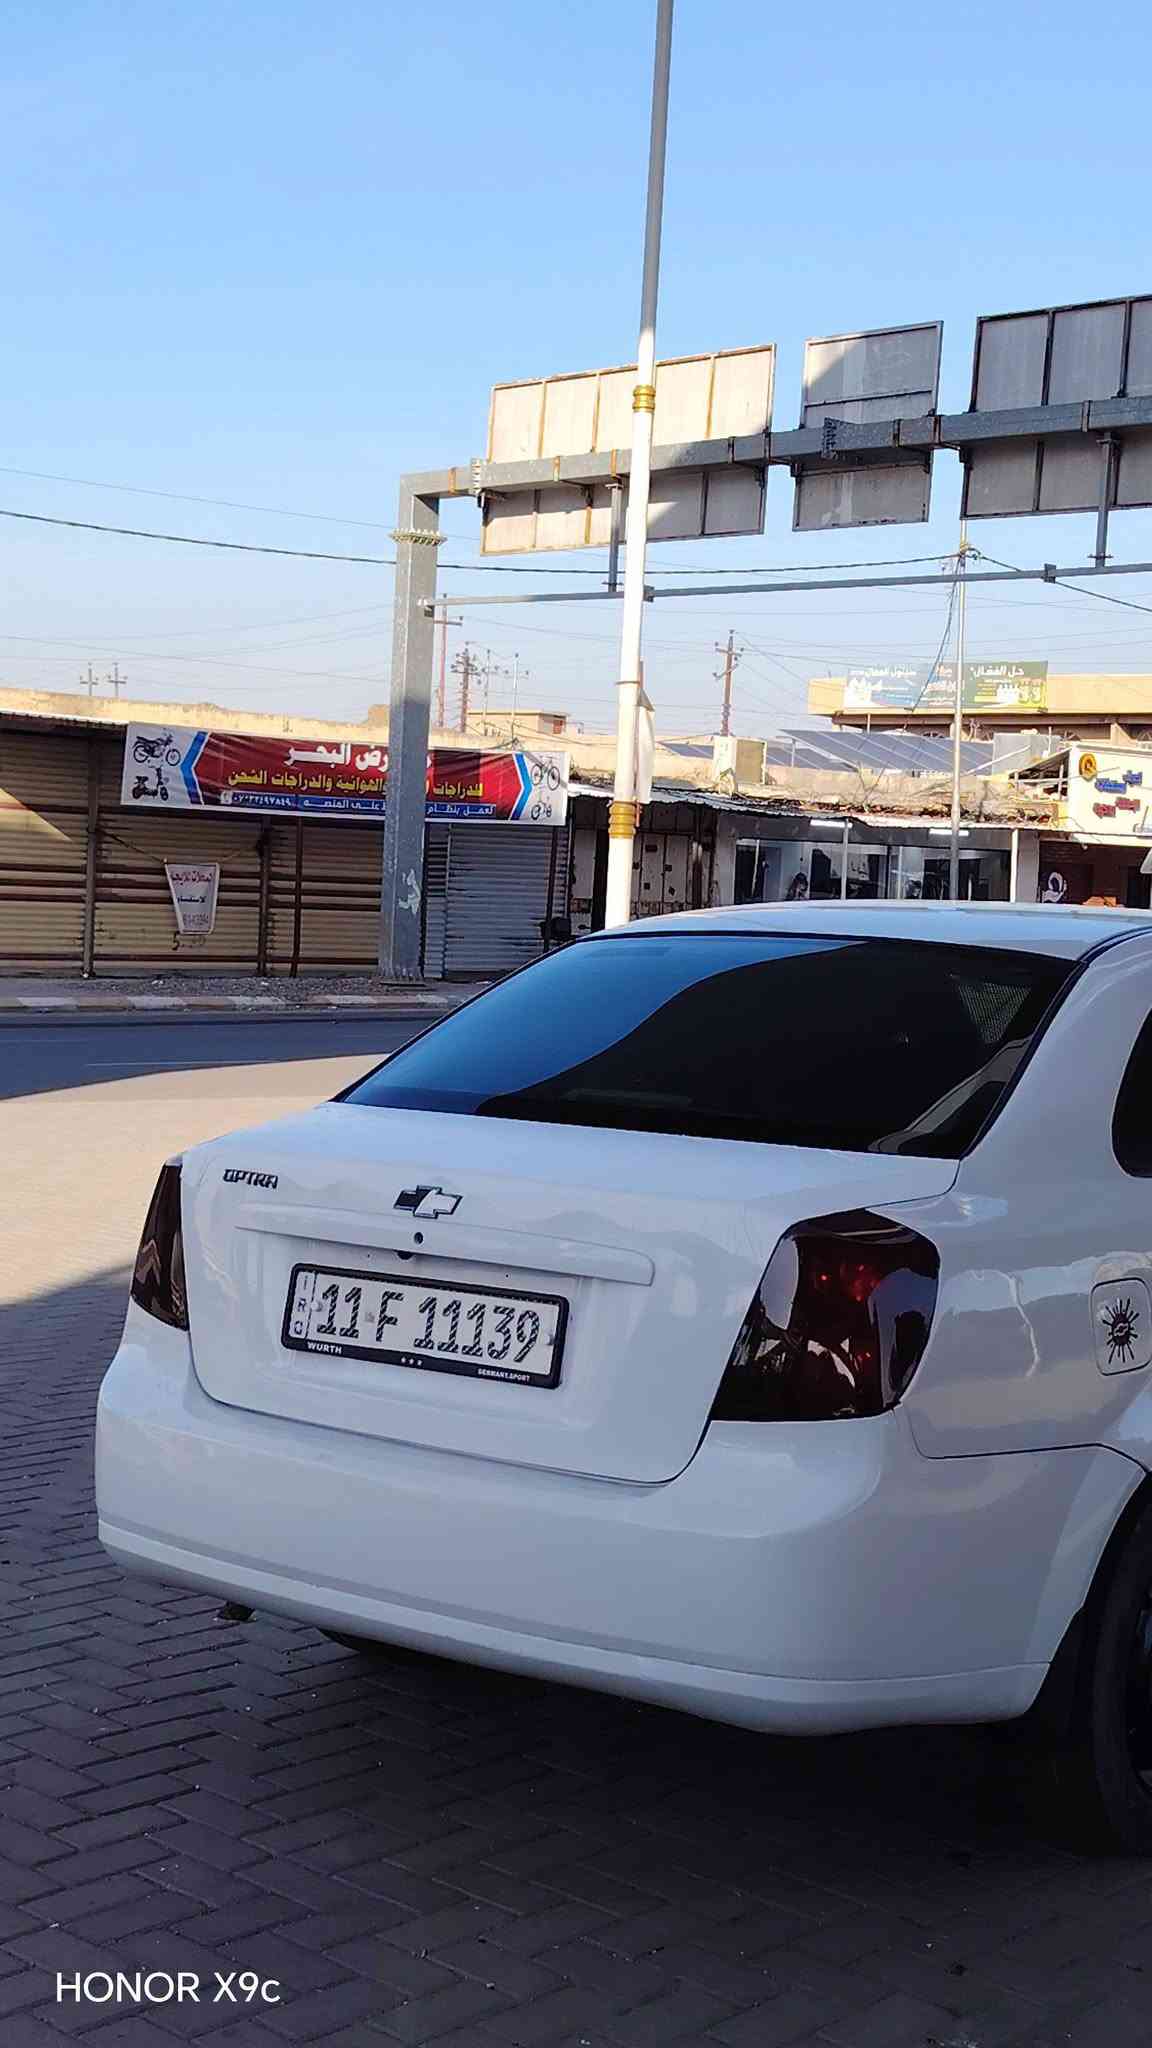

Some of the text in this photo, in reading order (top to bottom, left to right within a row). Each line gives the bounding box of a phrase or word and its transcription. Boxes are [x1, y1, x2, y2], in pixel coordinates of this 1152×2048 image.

[284, 743, 351, 768] البحر
[271, 770, 333, 792] والدراجات
[433, 780, 483, 799] للدراجات
[224, 1169, 278, 1189] OPTRA
[316, 1284, 540, 1363] 11 F 11139
[307, 1341, 342, 1355] WURTH
